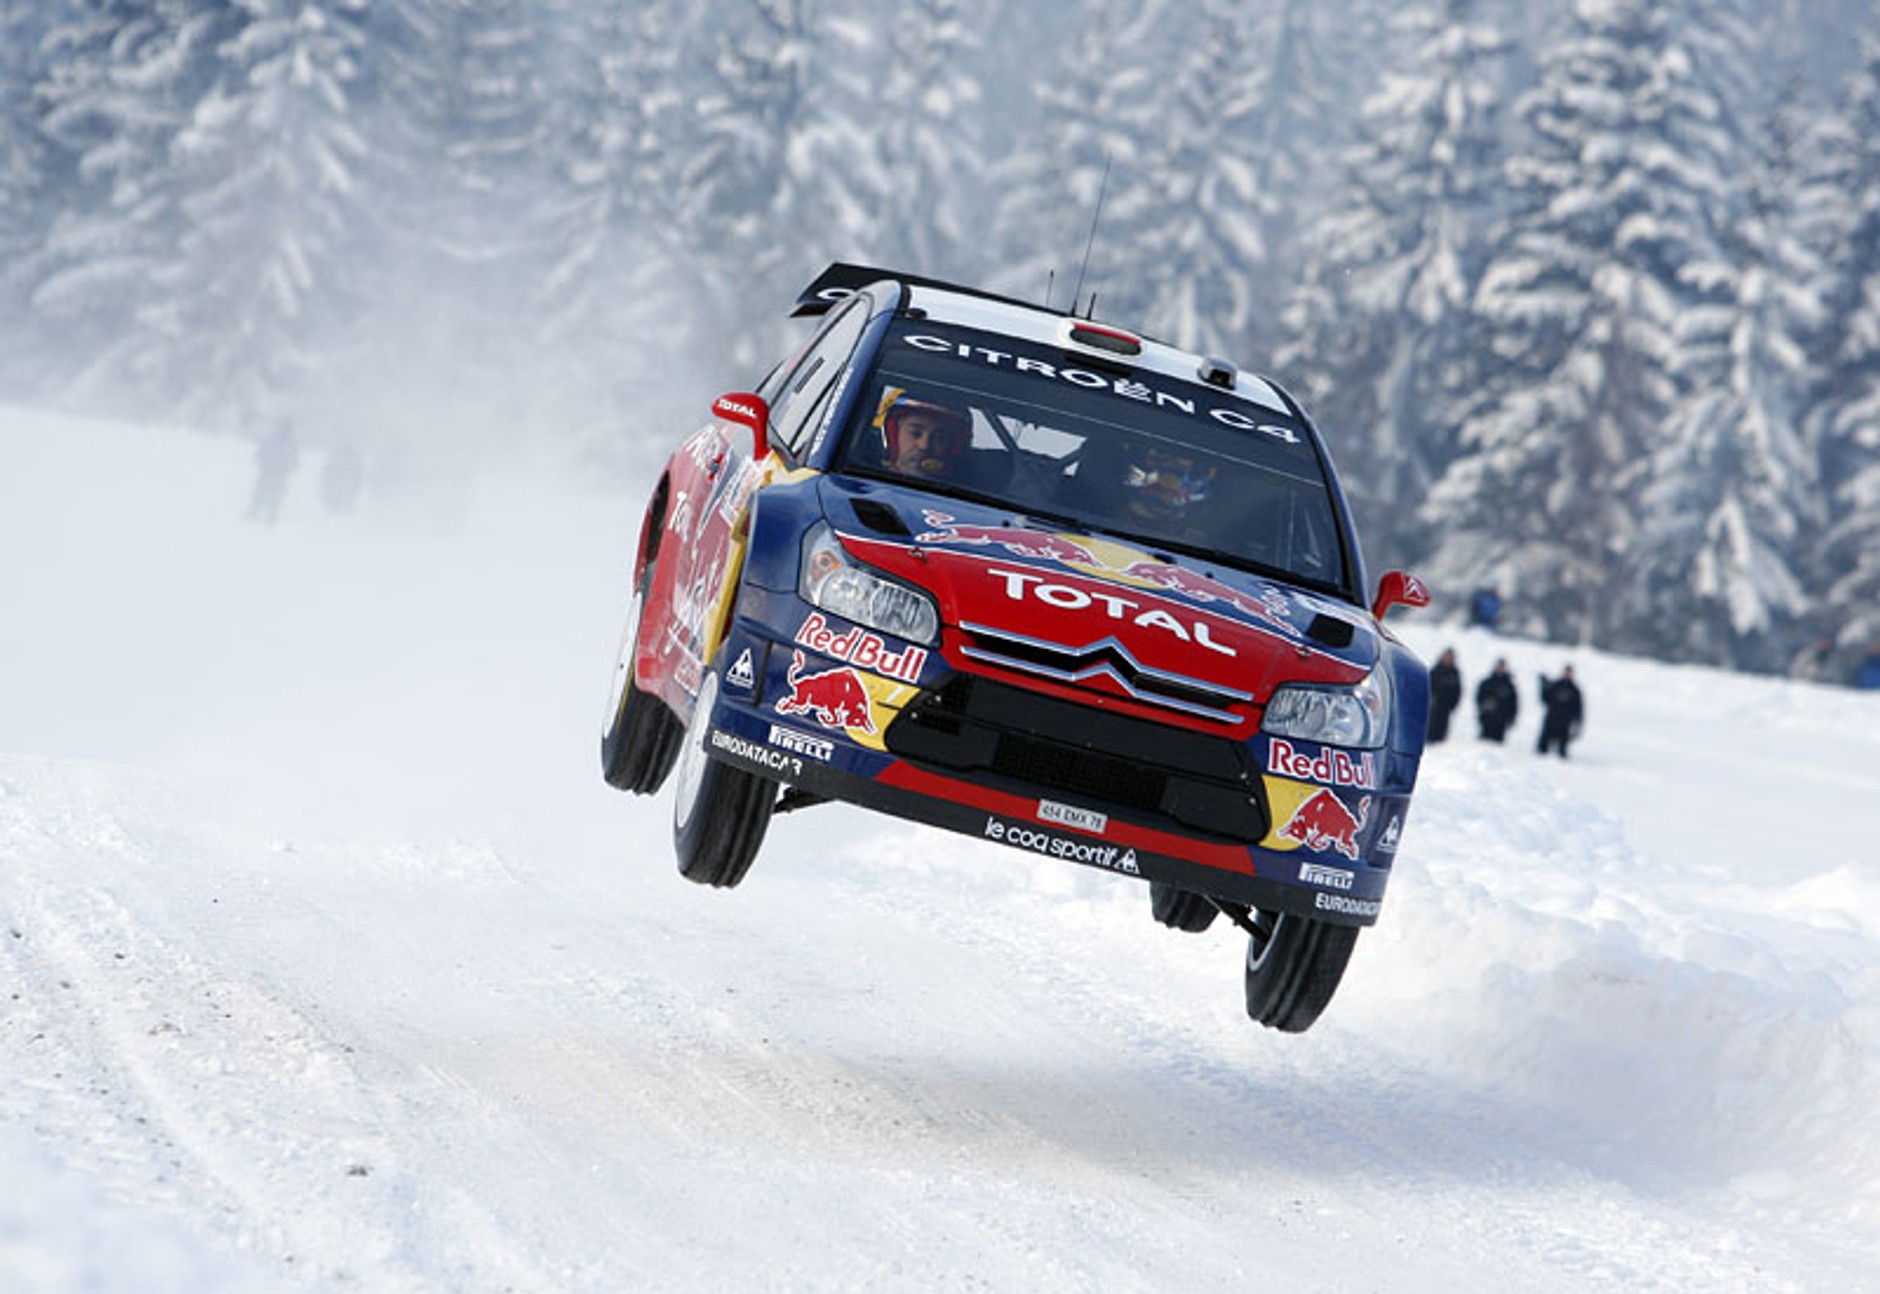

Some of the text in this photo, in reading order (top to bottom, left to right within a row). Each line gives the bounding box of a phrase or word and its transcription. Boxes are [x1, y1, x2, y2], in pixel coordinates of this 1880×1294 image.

[717, 398, 758, 419] TOTAL
[1209, 408, 1301, 444] C4
[987, 568, 1238, 657] TOTAL
[795, 611, 928, 684] Red Bull
[768, 724, 834, 762] PIRELLI
[1268, 738, 1333, 784] Red
[984, 815, 1117, 867] le coq sportif
[1298, 862, 1355, 890] PIRELLI
